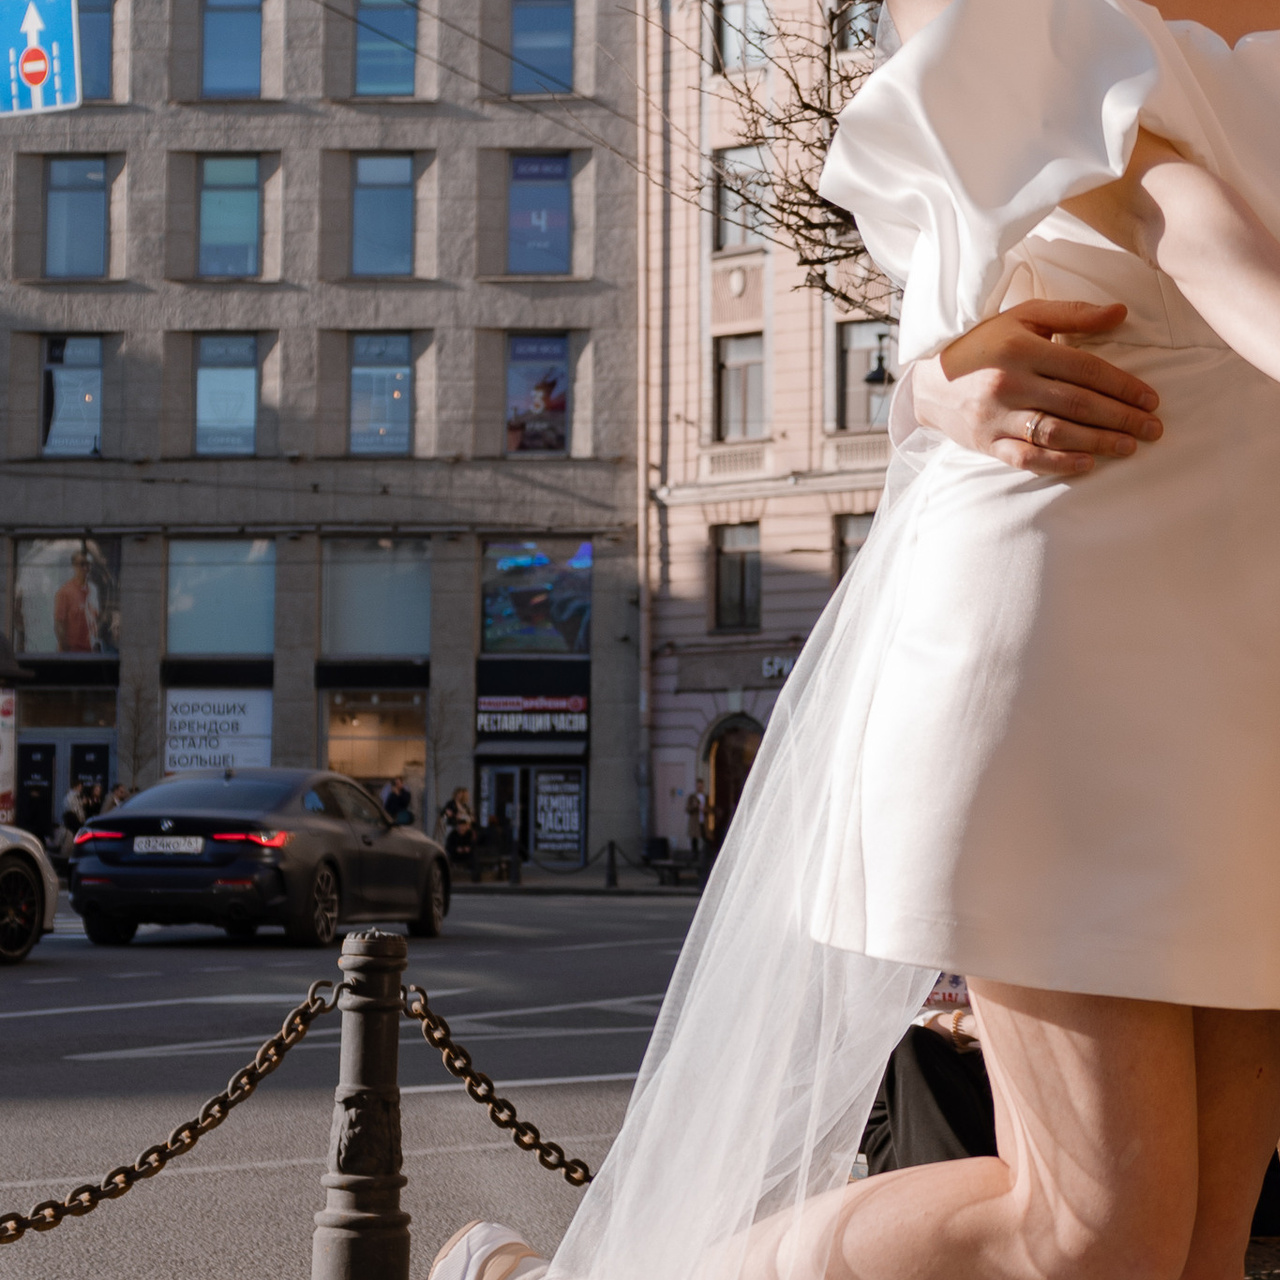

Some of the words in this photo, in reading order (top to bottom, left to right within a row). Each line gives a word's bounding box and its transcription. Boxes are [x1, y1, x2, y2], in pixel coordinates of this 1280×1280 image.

[530, 209, 547, 233] 4
[529, 389, 545, 415] 3
[170, 703, 248, 716] ХОРОШИХ
[169, 721, 240, 735] БРЕНДОВ
[168, 736, 220, 749] СТАЛО
[168, 754, 235, 768] БОЛЬШЕ!
